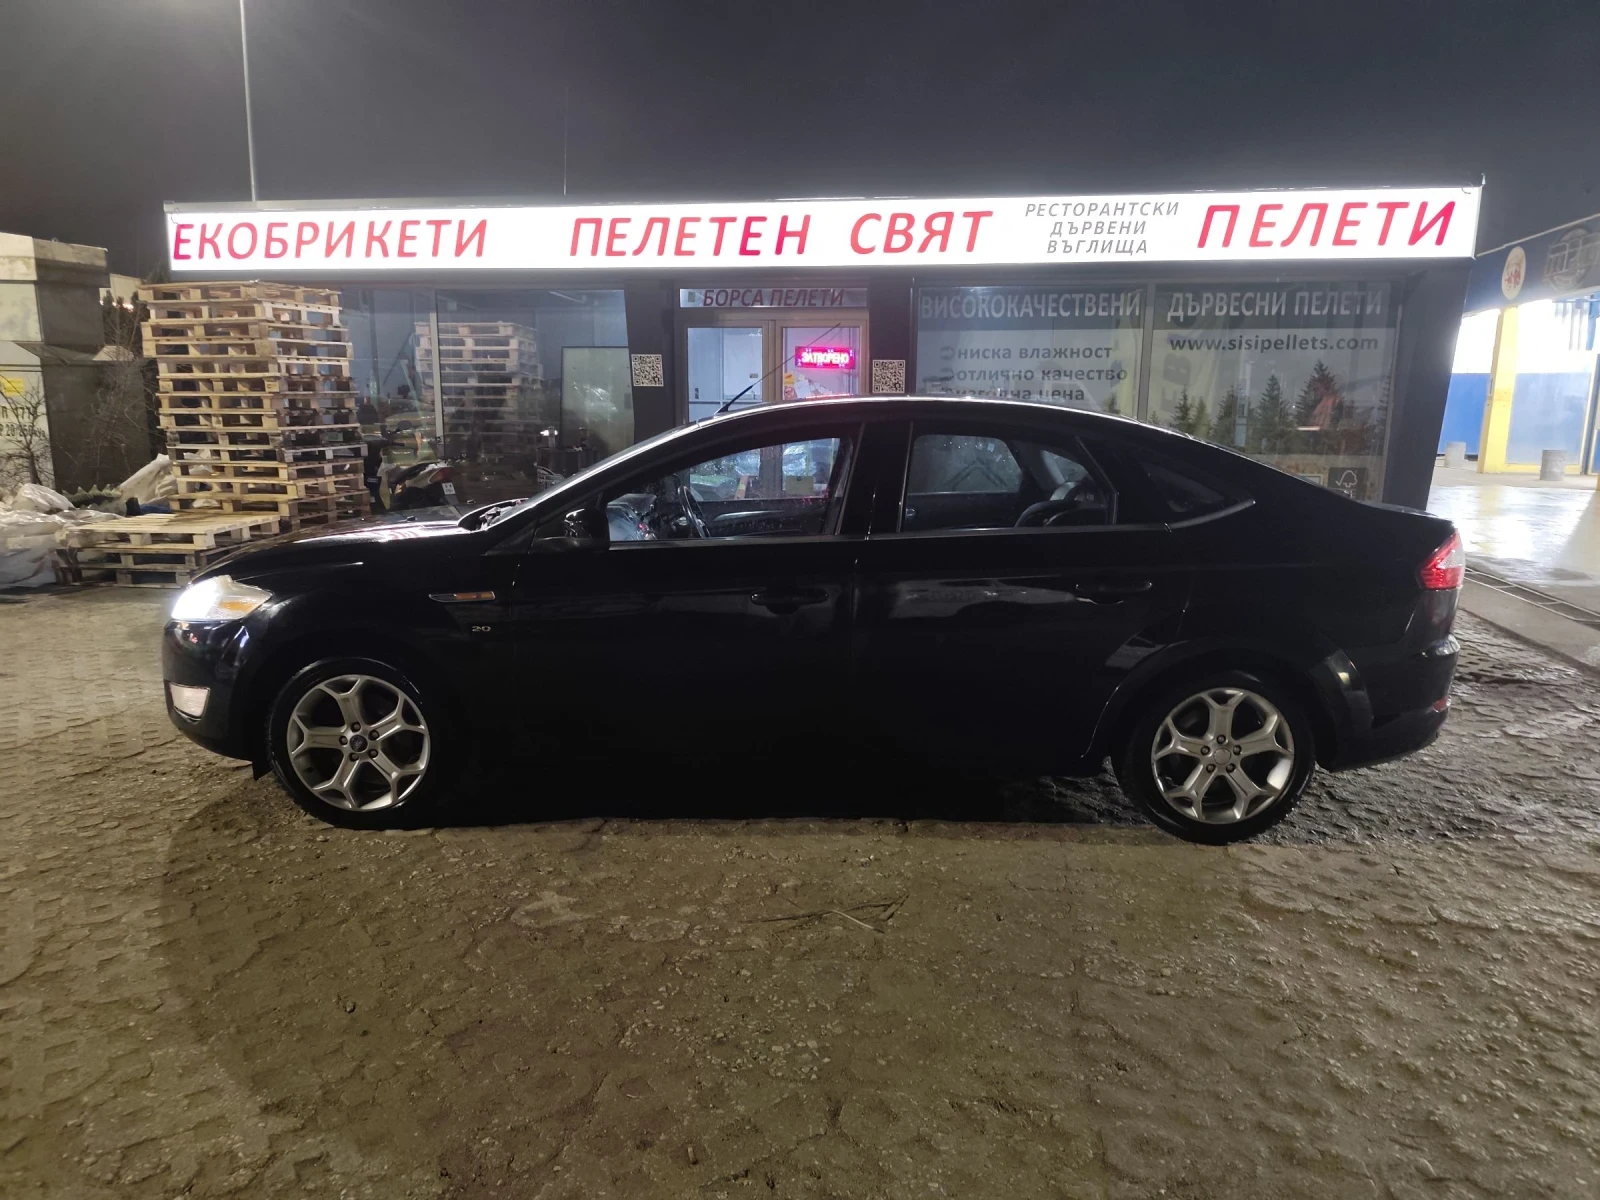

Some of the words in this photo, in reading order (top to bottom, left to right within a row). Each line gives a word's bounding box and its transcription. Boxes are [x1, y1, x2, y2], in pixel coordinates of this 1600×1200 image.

[1024, 201, 1179, 218] РЕСТОРАНТСКИ
[569, 214, 812, 257] ПЕЛЕТЕН
[849, 210, 994, 255] СВЯТ
[1050, 220, 1146, 237] ДЪРВЕНИ
[1197, 200, 1456, 249] ПЕЛЕТИ
[173, 218, 488, 260] ЕКОБРИКЕТИ
[1046, 239, 1148, 256] ВЪГЛИЩА
[702, 289, 764, 307] БОРСА
[769, 288, 846, 307] ПЕЛЕТИ
[920, 292, 1141, 319] ВИСОКОКАЧЕСТВЕНИ
[1166, 291, 1287, 322] ДЪРВЕСНИ
[1293, 290, 1383, 316] ПЕЛЕТИ
[957, 346, 1012, 360] ниска
[1018, 345, 1113, 360] влажност
[1170, 334, 1379, 354] www.sisipellets.com
[956, 368, 1035, 382] отлично
[1041, 367, 1129, 382] качество
